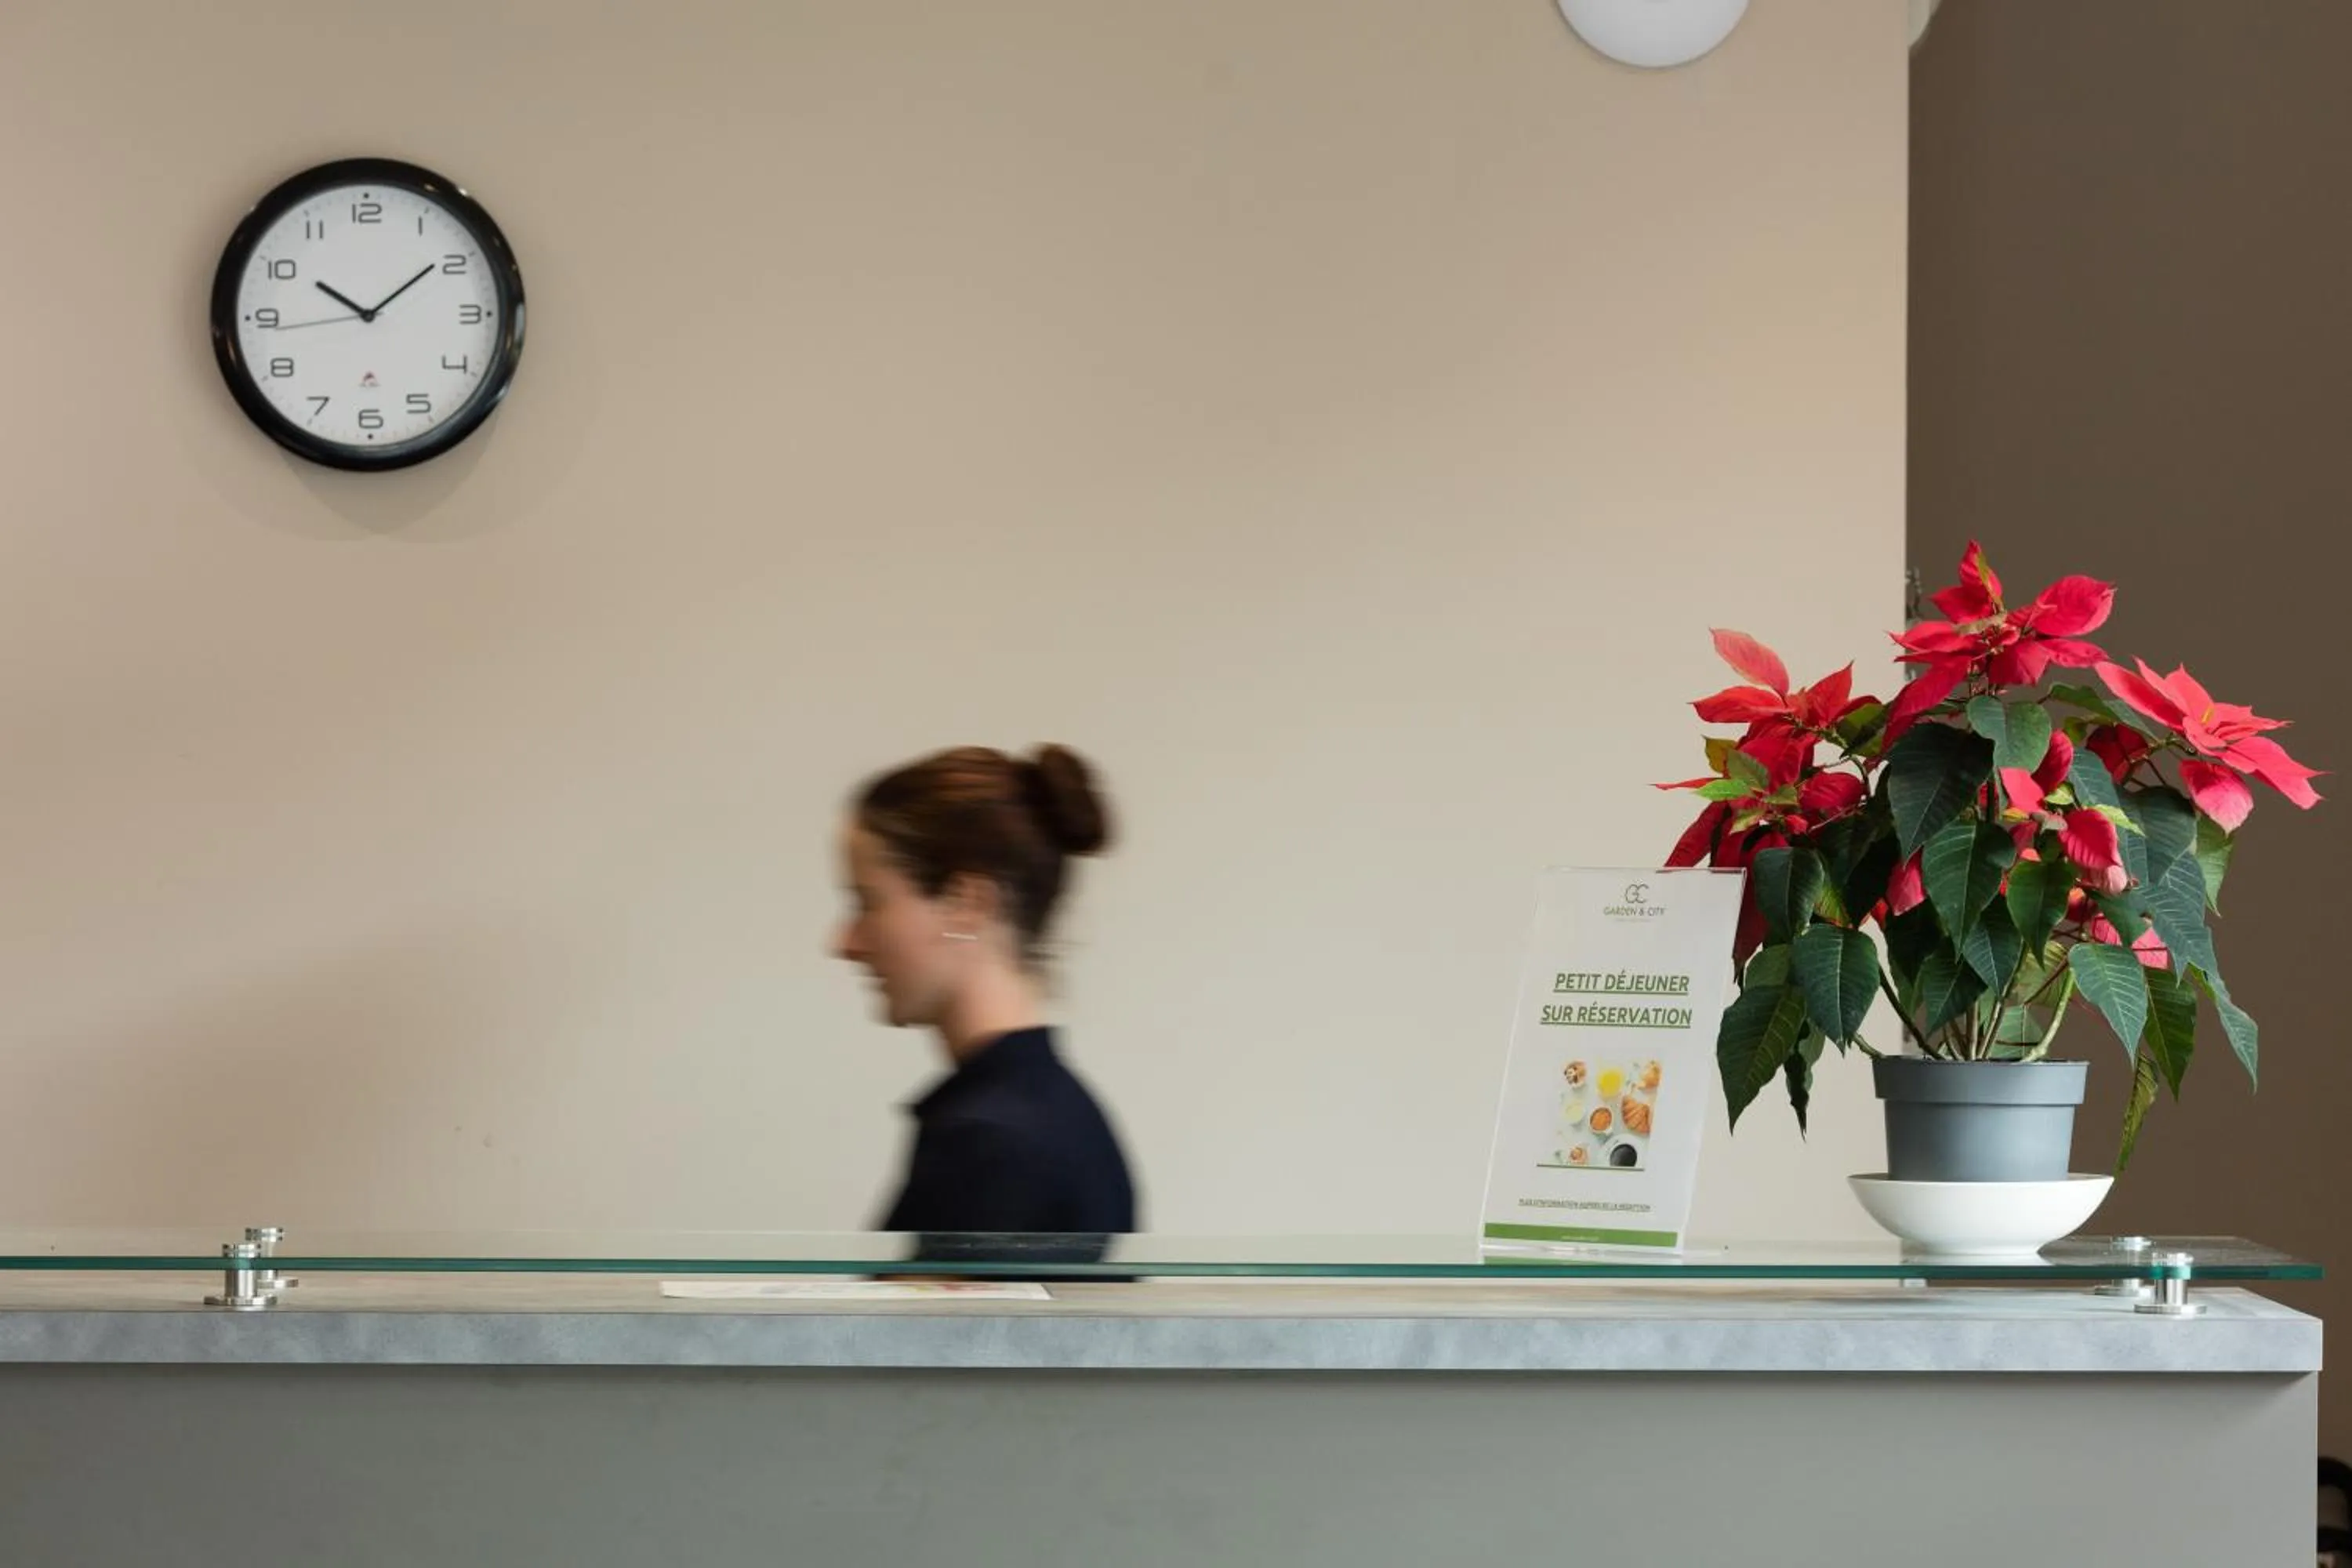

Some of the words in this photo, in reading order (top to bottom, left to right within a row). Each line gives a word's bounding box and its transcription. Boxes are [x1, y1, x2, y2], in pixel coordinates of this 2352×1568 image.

[351, 203, 383, 223] 12
[306, 220, 324, 239] 11
[267, 259, 296, 280] 10
[442, 254, 467, 274] 2
[255, 307, 279, 328] 9
[459, 303, 482, 325] 3
[270, 357, 294, 378] 8
[441, 354, 467, 375] 4
[307, 396, 330, 416] 7
[406, 394, 432, 414] 5
[358, 408, 383, 429] 6
[1555, 972, 1602, 989] PETIT
[1604, 969, 1690, 992] DÉJEUNER
[1541, 1004, 1573, 1022] SUR
[1577, 1000, 1693, 1025] RÉSERVATION
